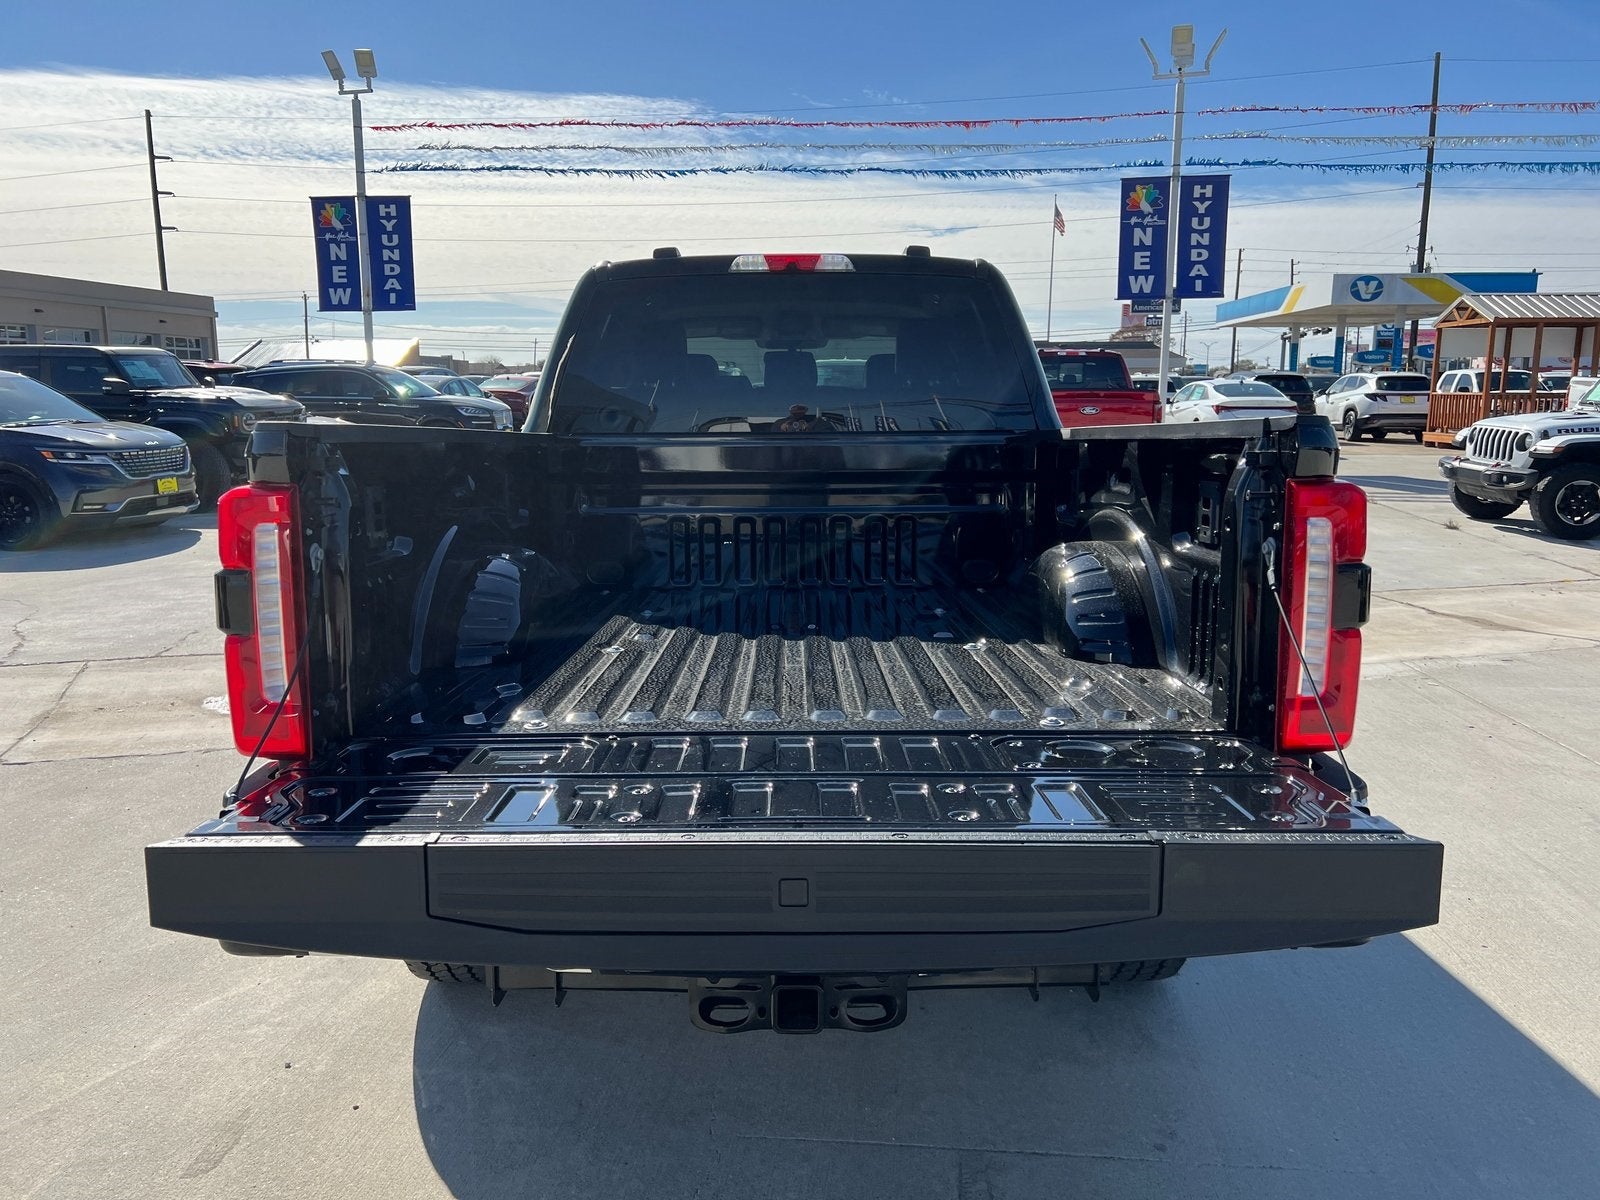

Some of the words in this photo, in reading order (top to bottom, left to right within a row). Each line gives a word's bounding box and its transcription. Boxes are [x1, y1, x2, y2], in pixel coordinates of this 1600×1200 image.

[328, 243, 352, 305] NEW
[378, 204, 402, 304] HYUNDAI
[1128, 227, 1155, 294] NEW
[1189, 185, 1213, 292] HYUNDAI
